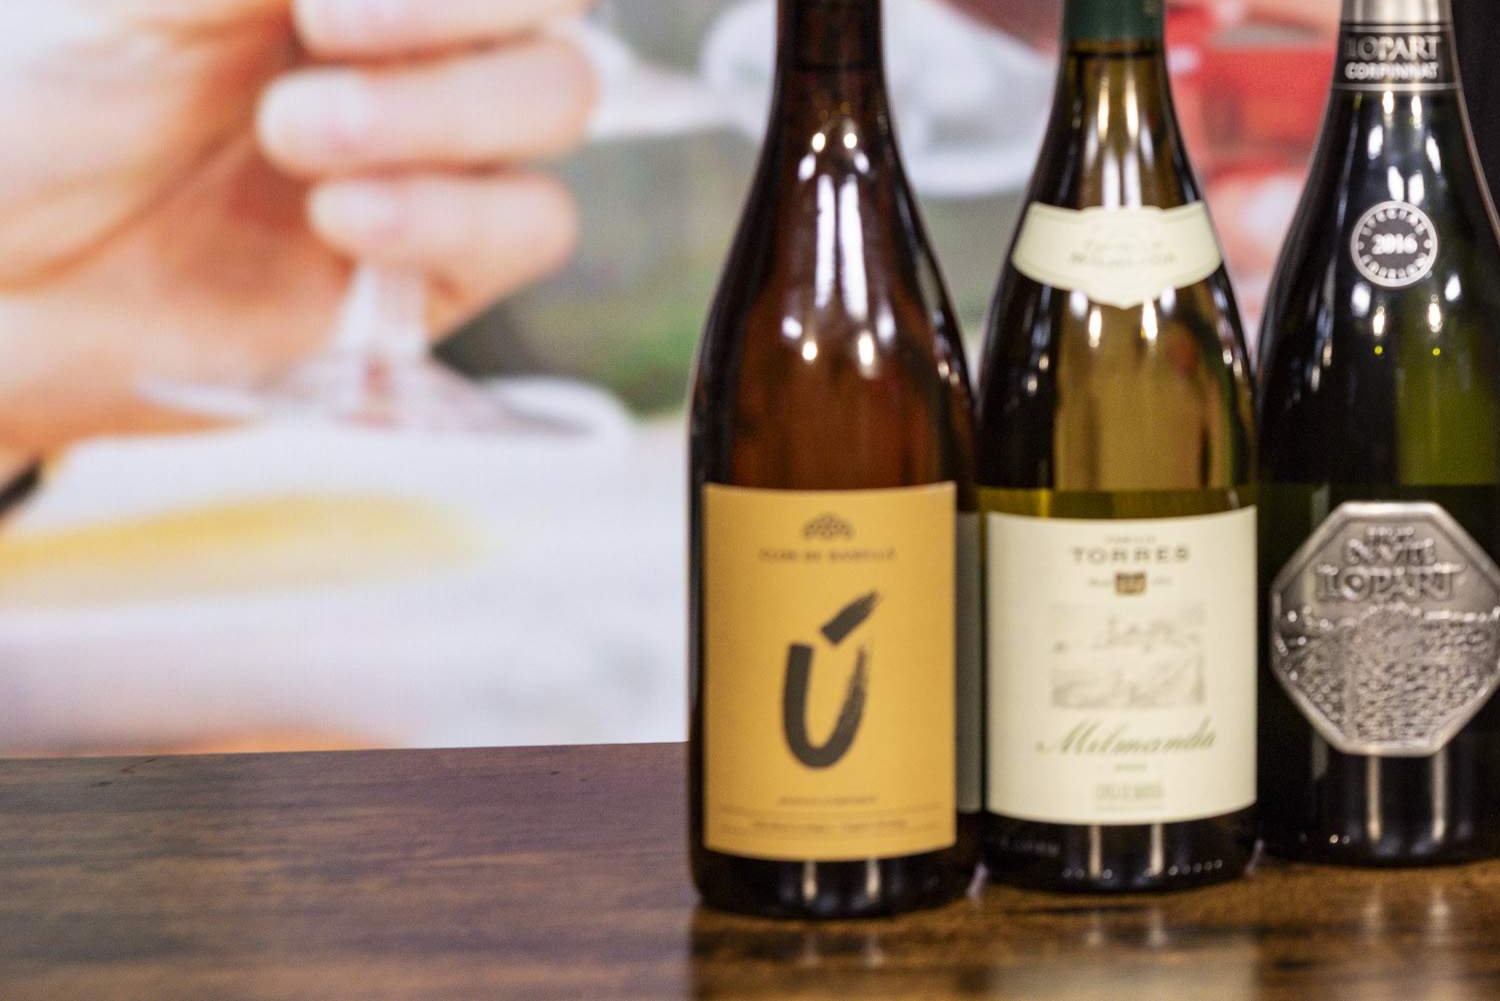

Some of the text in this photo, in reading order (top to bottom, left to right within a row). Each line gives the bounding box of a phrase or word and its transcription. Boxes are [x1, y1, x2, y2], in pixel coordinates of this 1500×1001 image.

[1371, 232, 1418, 256] 2016
[1070, 542, 1192, 565] TORRES
[1034, 714, 1217, 755] Milmanda
